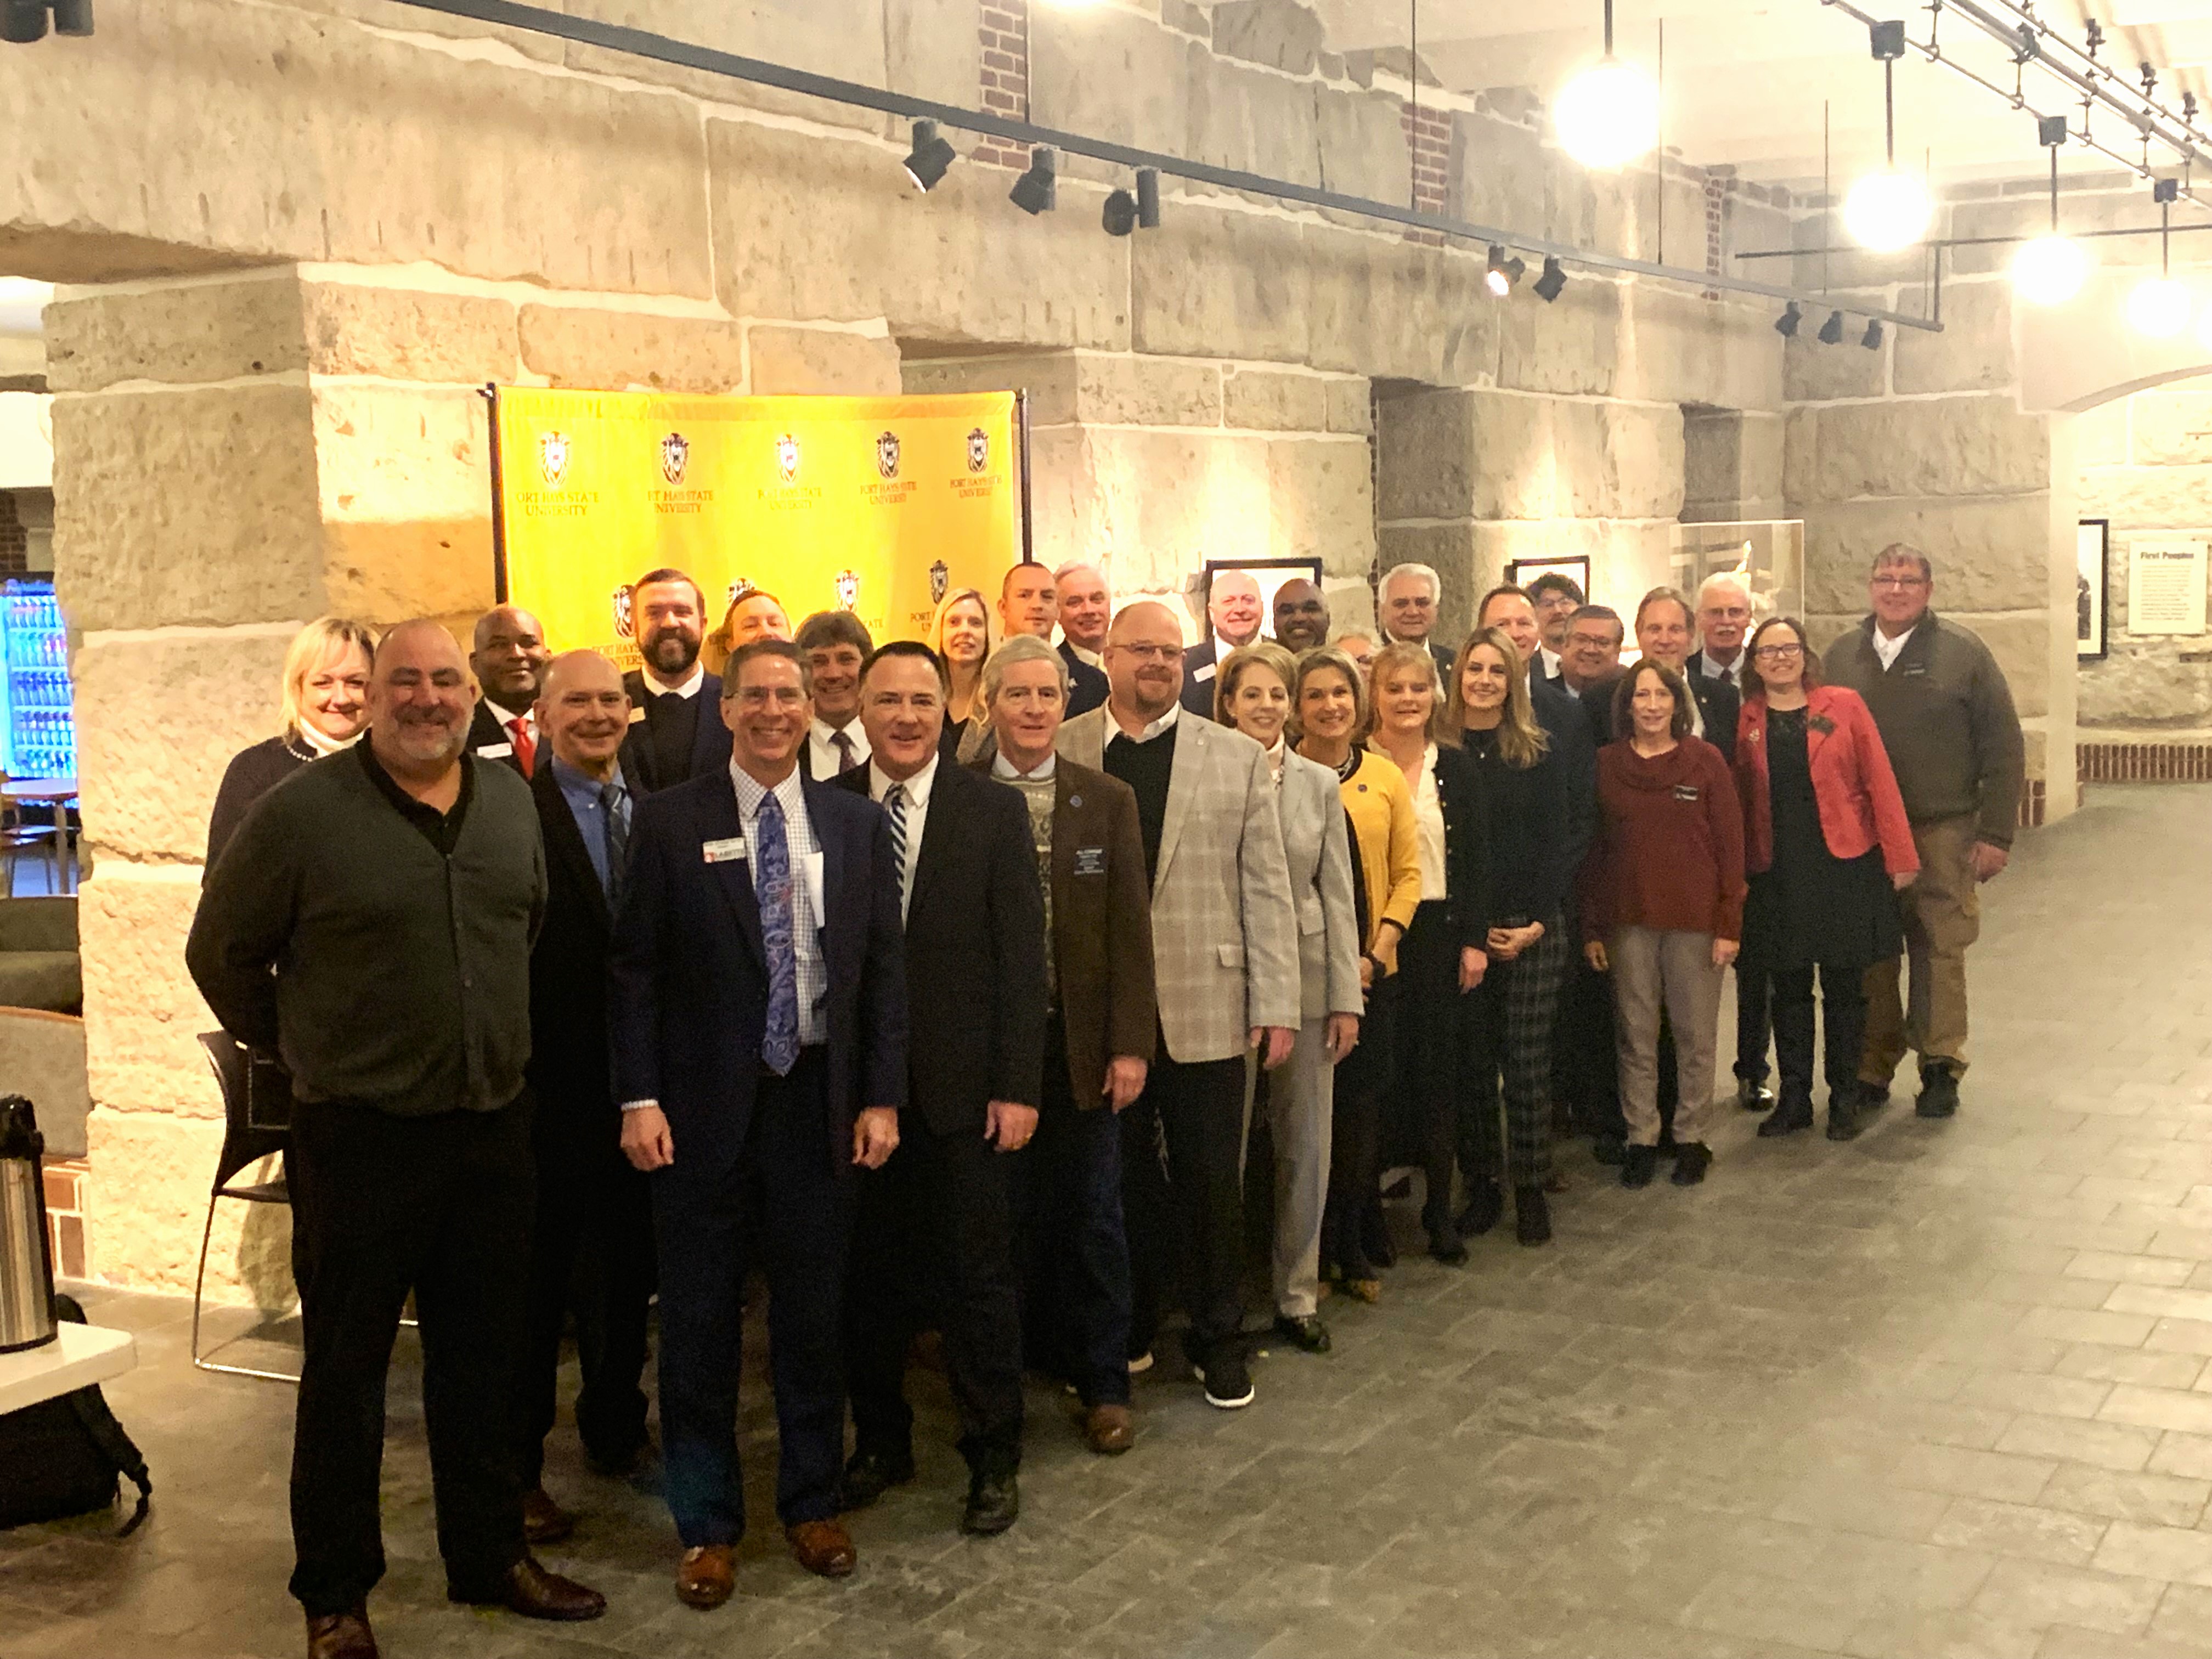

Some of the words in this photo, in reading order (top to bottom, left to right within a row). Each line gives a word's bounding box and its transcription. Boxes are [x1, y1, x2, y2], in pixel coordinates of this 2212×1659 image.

[567, 492, 599, 503] STATE
[686, 490, 713, 501] STATE
[526, 505, 588, 516] UNIVERSITY
[654, 503, 702, 513] NIVERSITY
[2140, 551, 2160, 560] First
[910, 612, 931, 623] FORT
